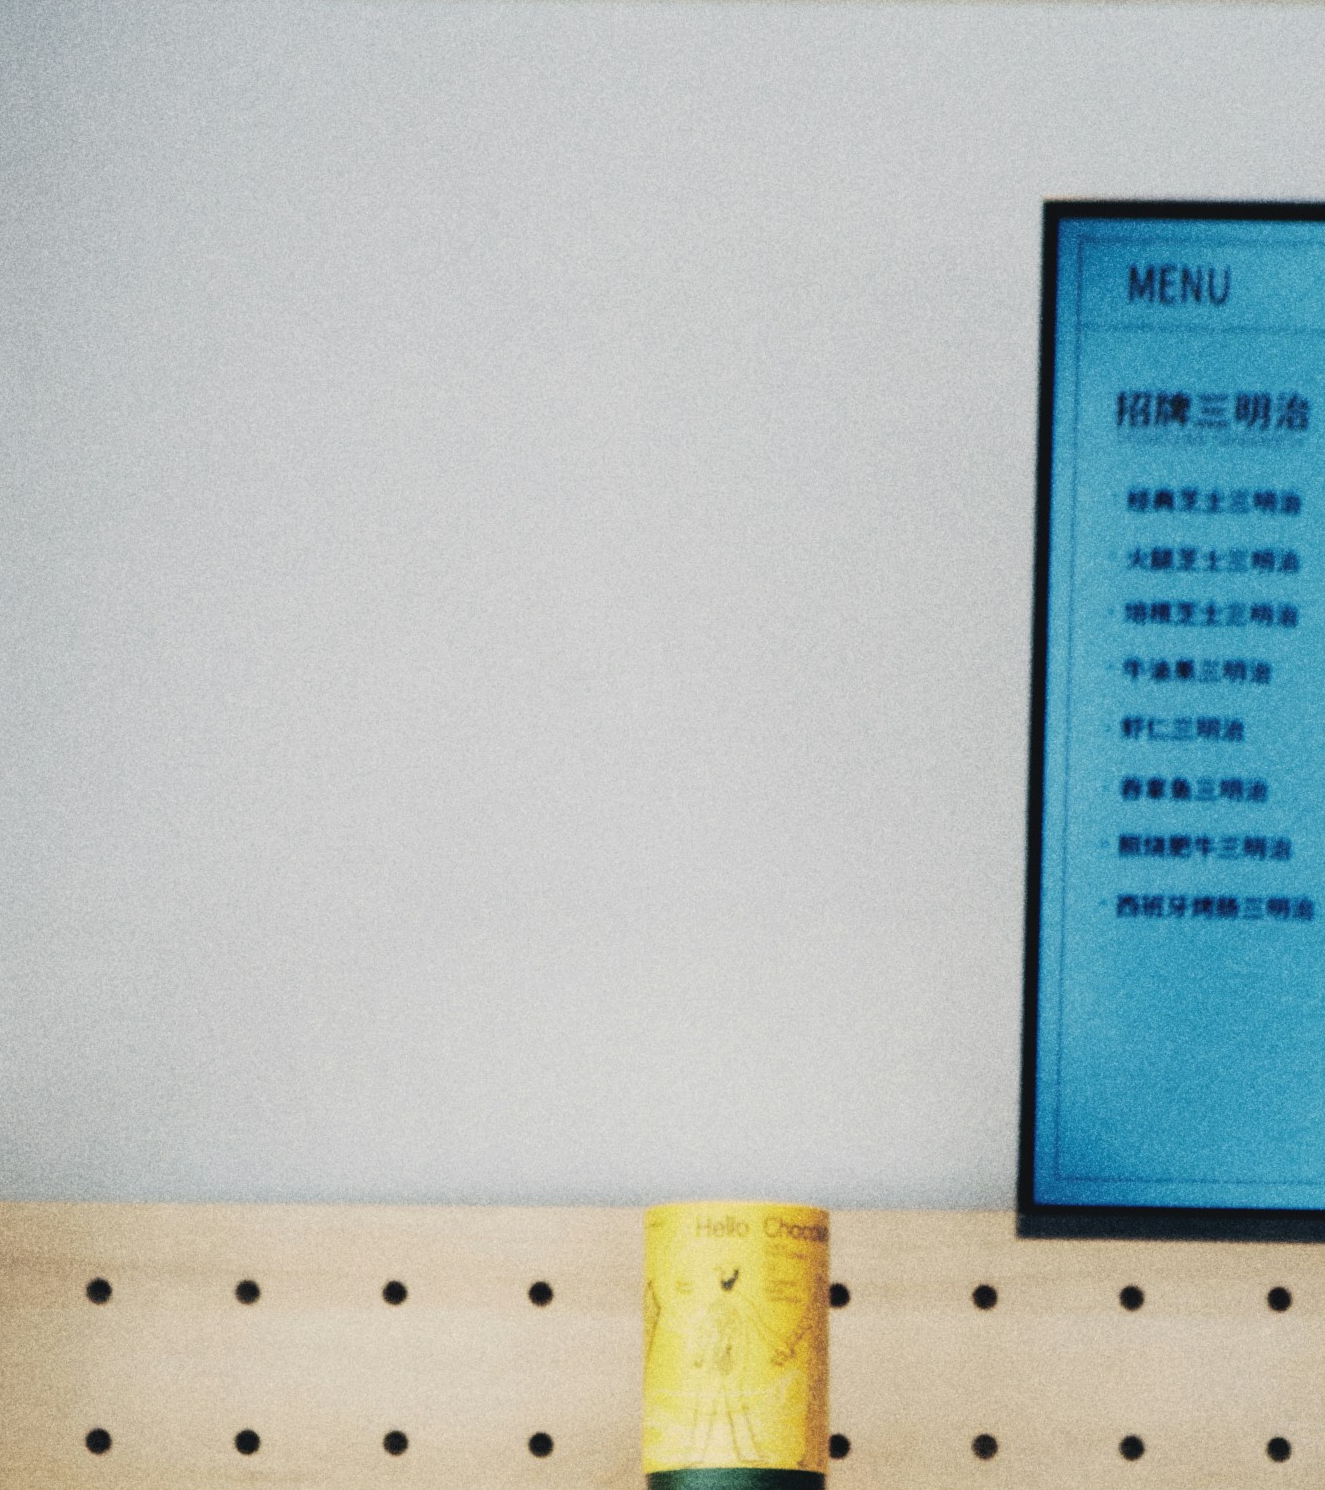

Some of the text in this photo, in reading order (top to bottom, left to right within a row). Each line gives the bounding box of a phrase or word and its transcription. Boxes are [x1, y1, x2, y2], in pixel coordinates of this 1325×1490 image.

[1128, 264, 1231, 307] MENU
[1117, 391, 1310, 430] 招牌三明治
[695, 1216, 749, 1239] Hello
